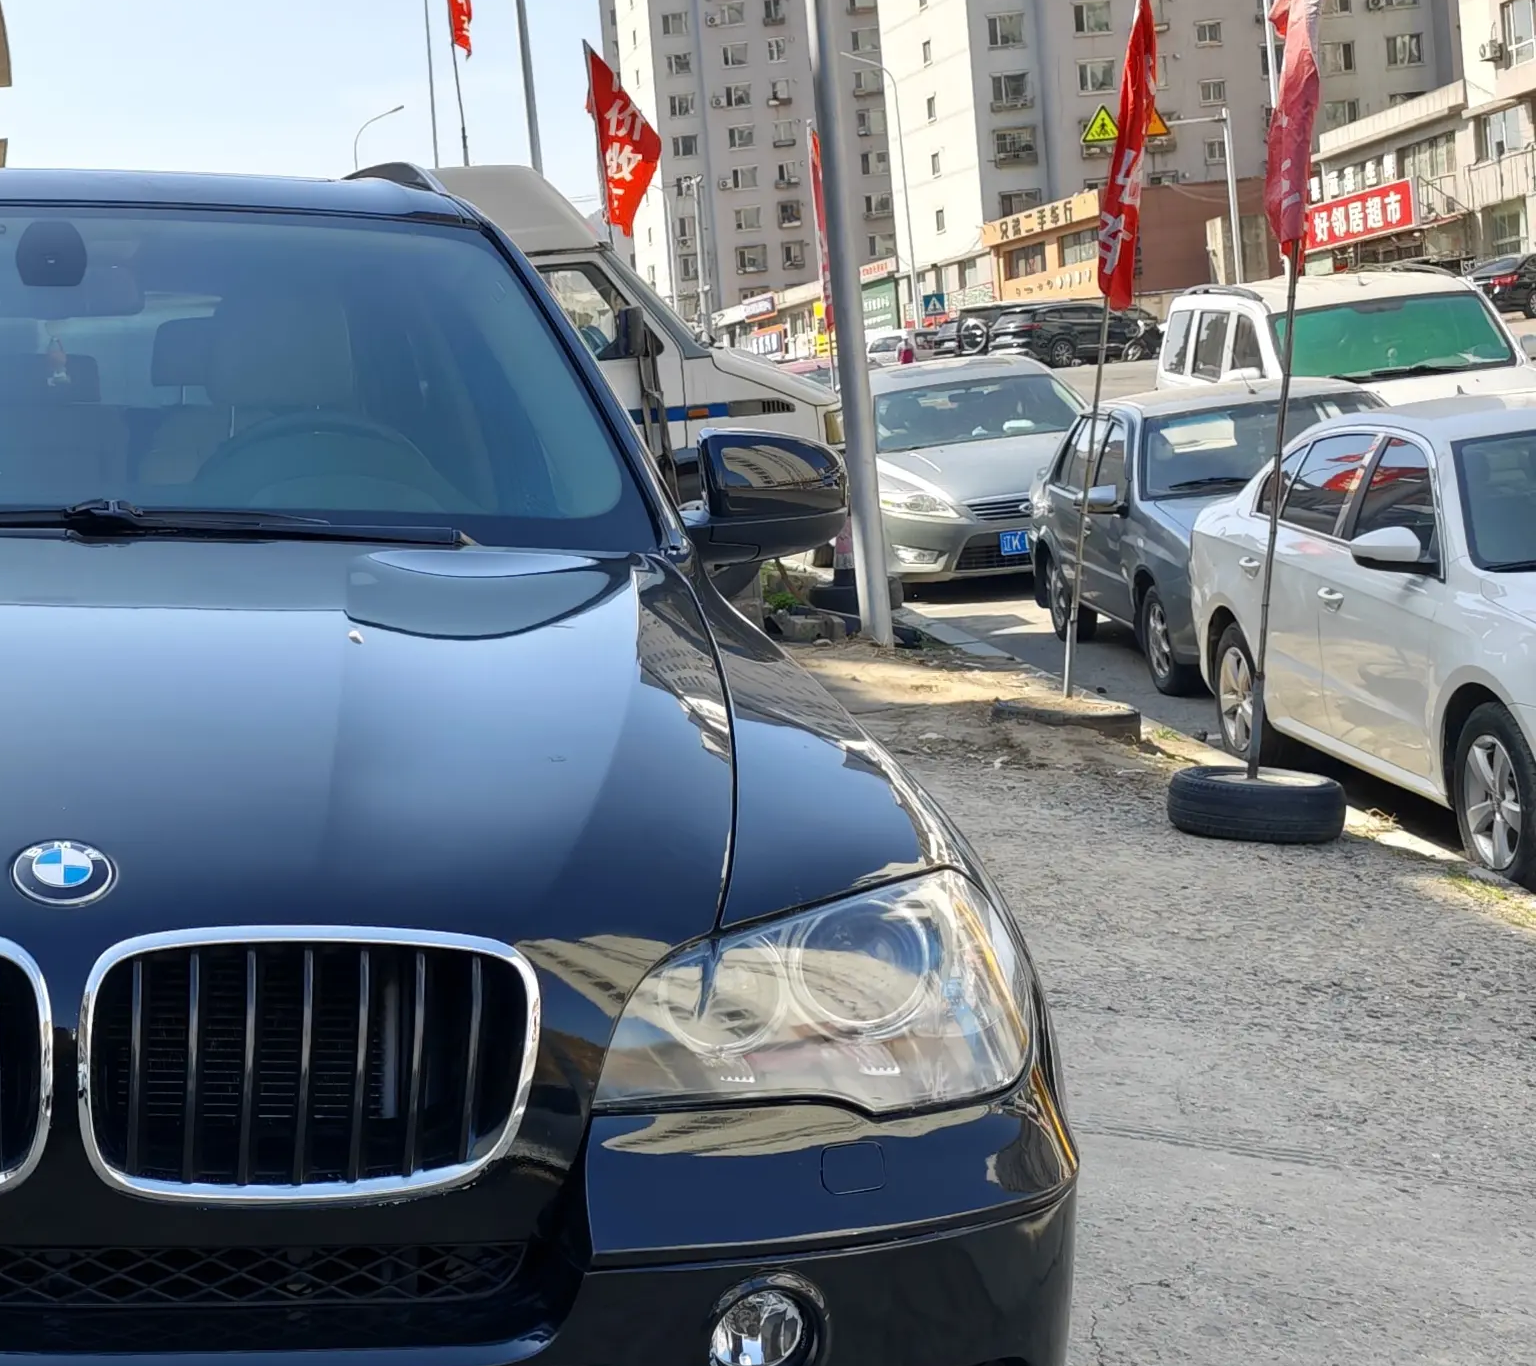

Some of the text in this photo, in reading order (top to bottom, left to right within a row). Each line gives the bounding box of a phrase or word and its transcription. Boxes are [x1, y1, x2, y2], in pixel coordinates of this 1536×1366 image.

[1313, 191, 1403, 243] 好邻居超市
[23, 841, 103, 860] BMW
